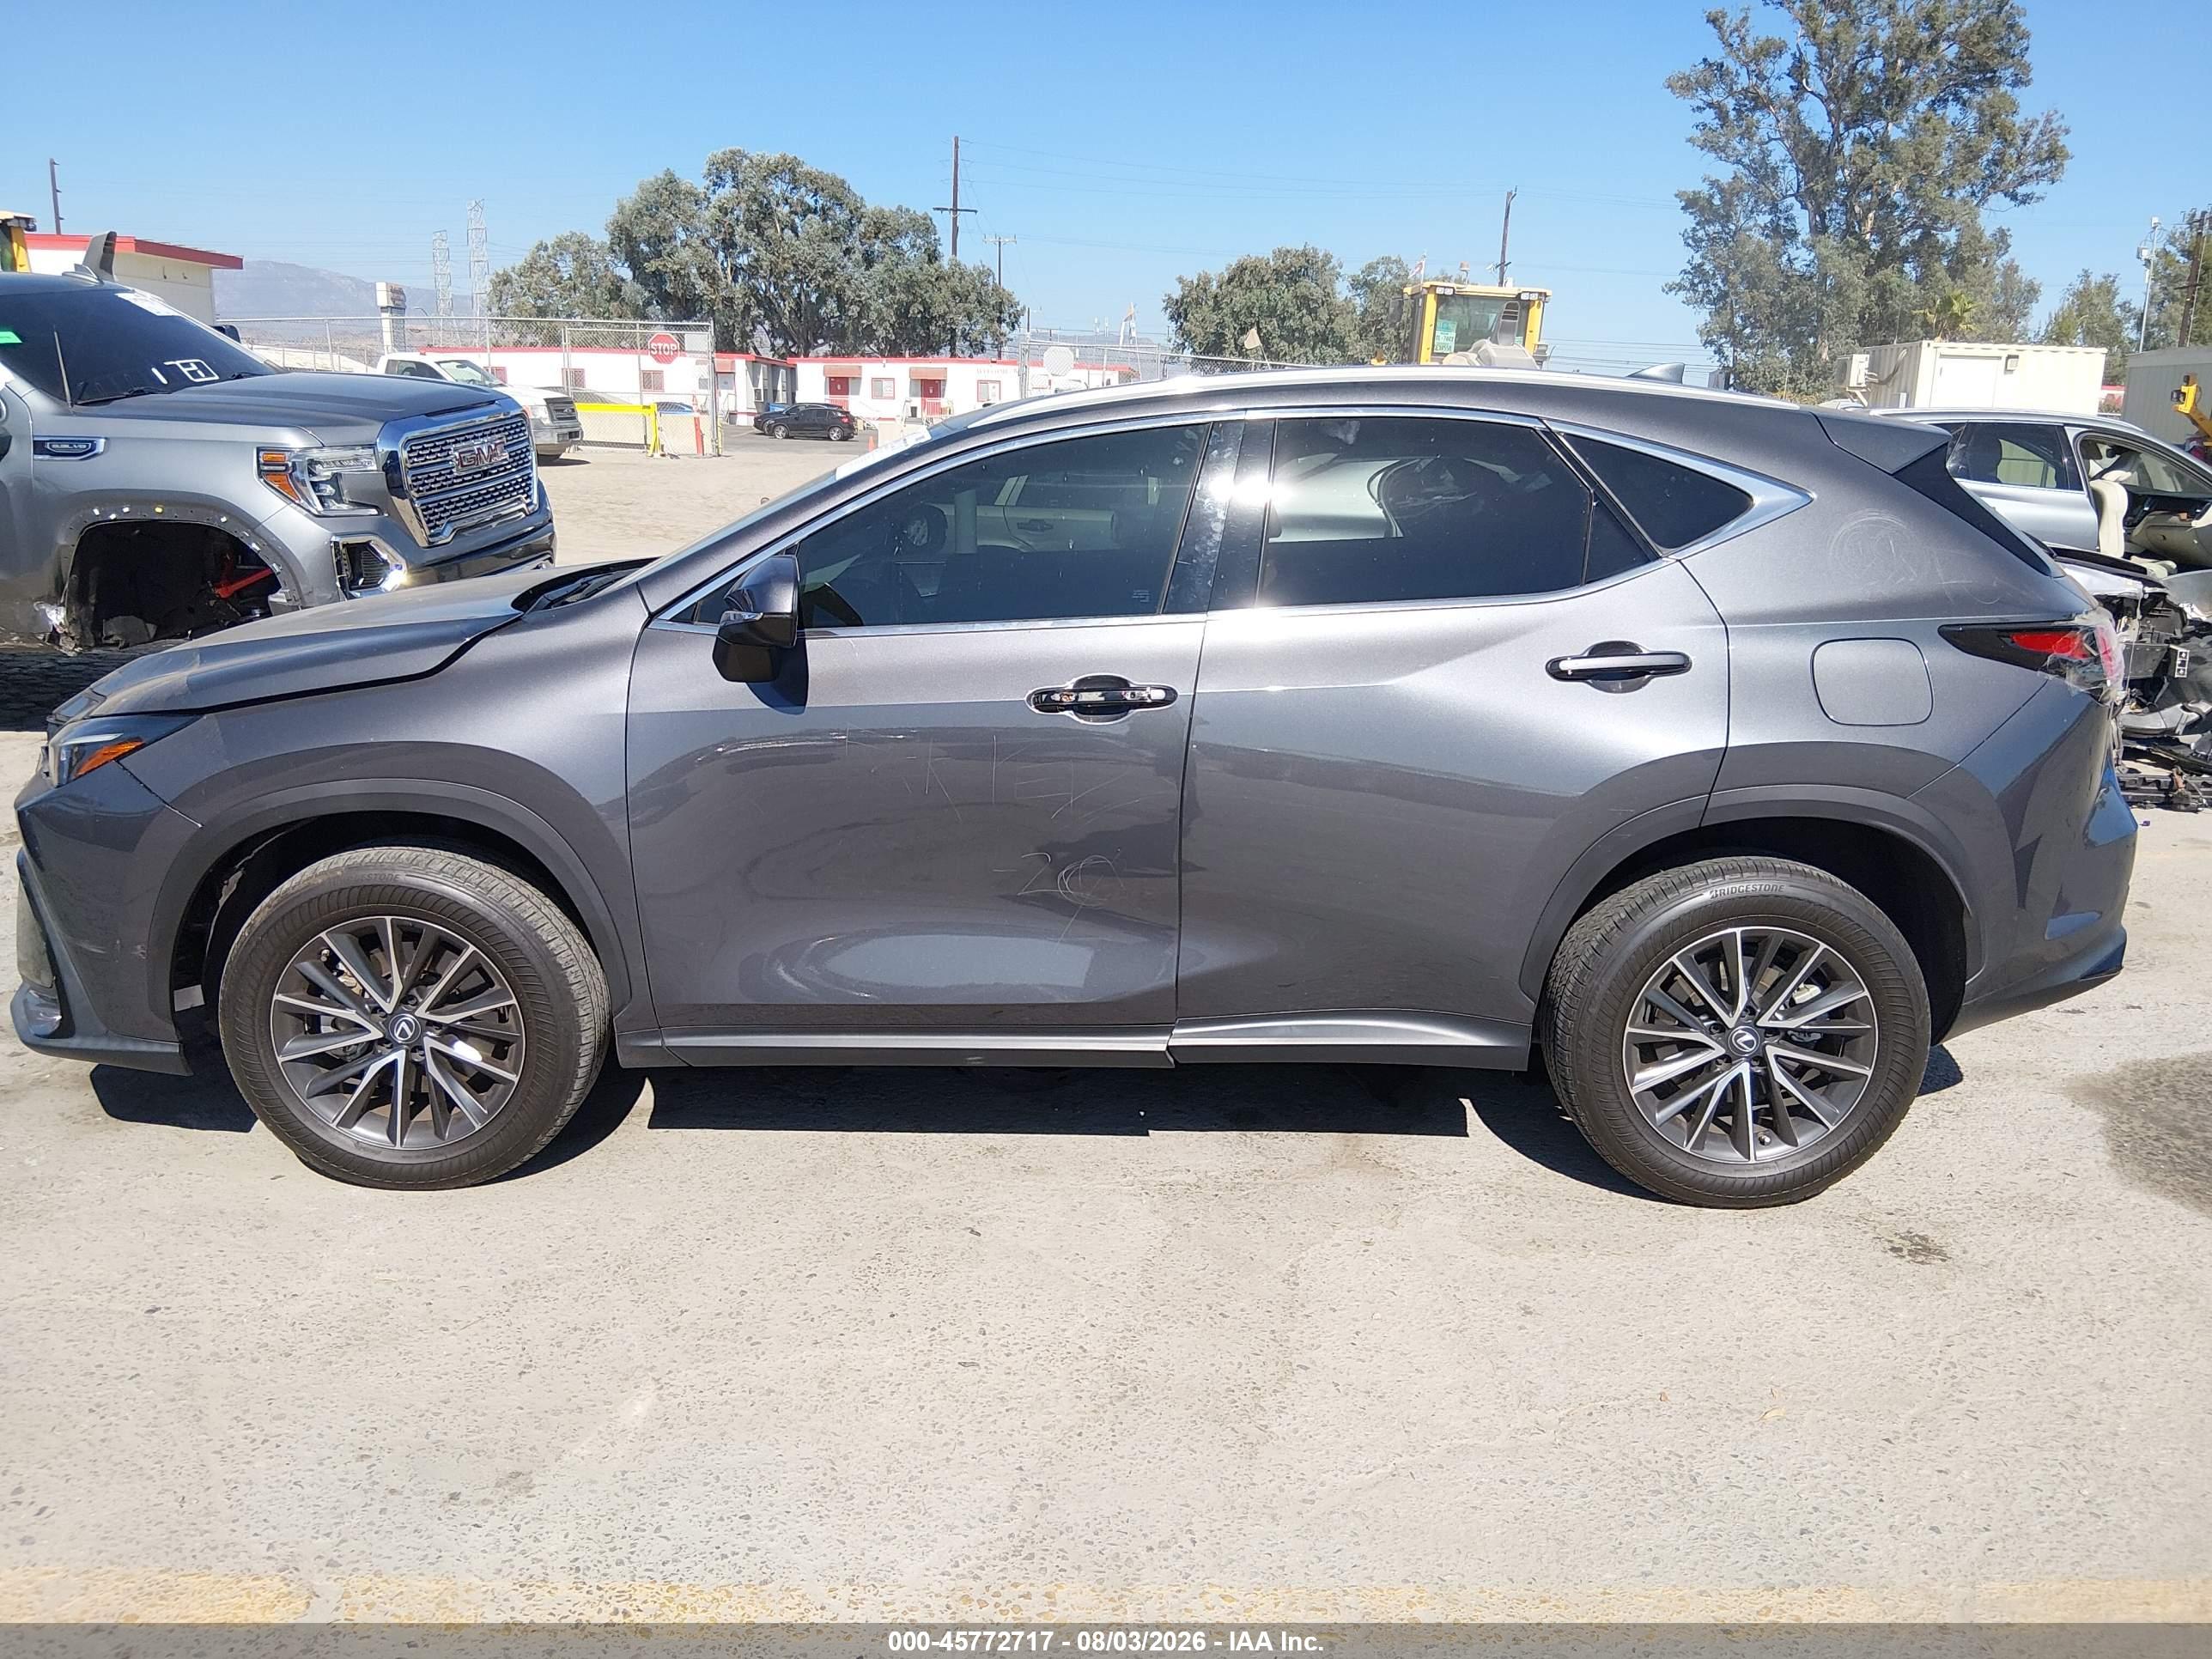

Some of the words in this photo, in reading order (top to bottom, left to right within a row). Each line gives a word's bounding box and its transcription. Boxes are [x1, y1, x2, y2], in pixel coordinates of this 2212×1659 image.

[650, 343, 678, 356] STOP
[457, 439, 508, 468] GMC
[1710, 884, 1785, 899] BRIDGESTONE
